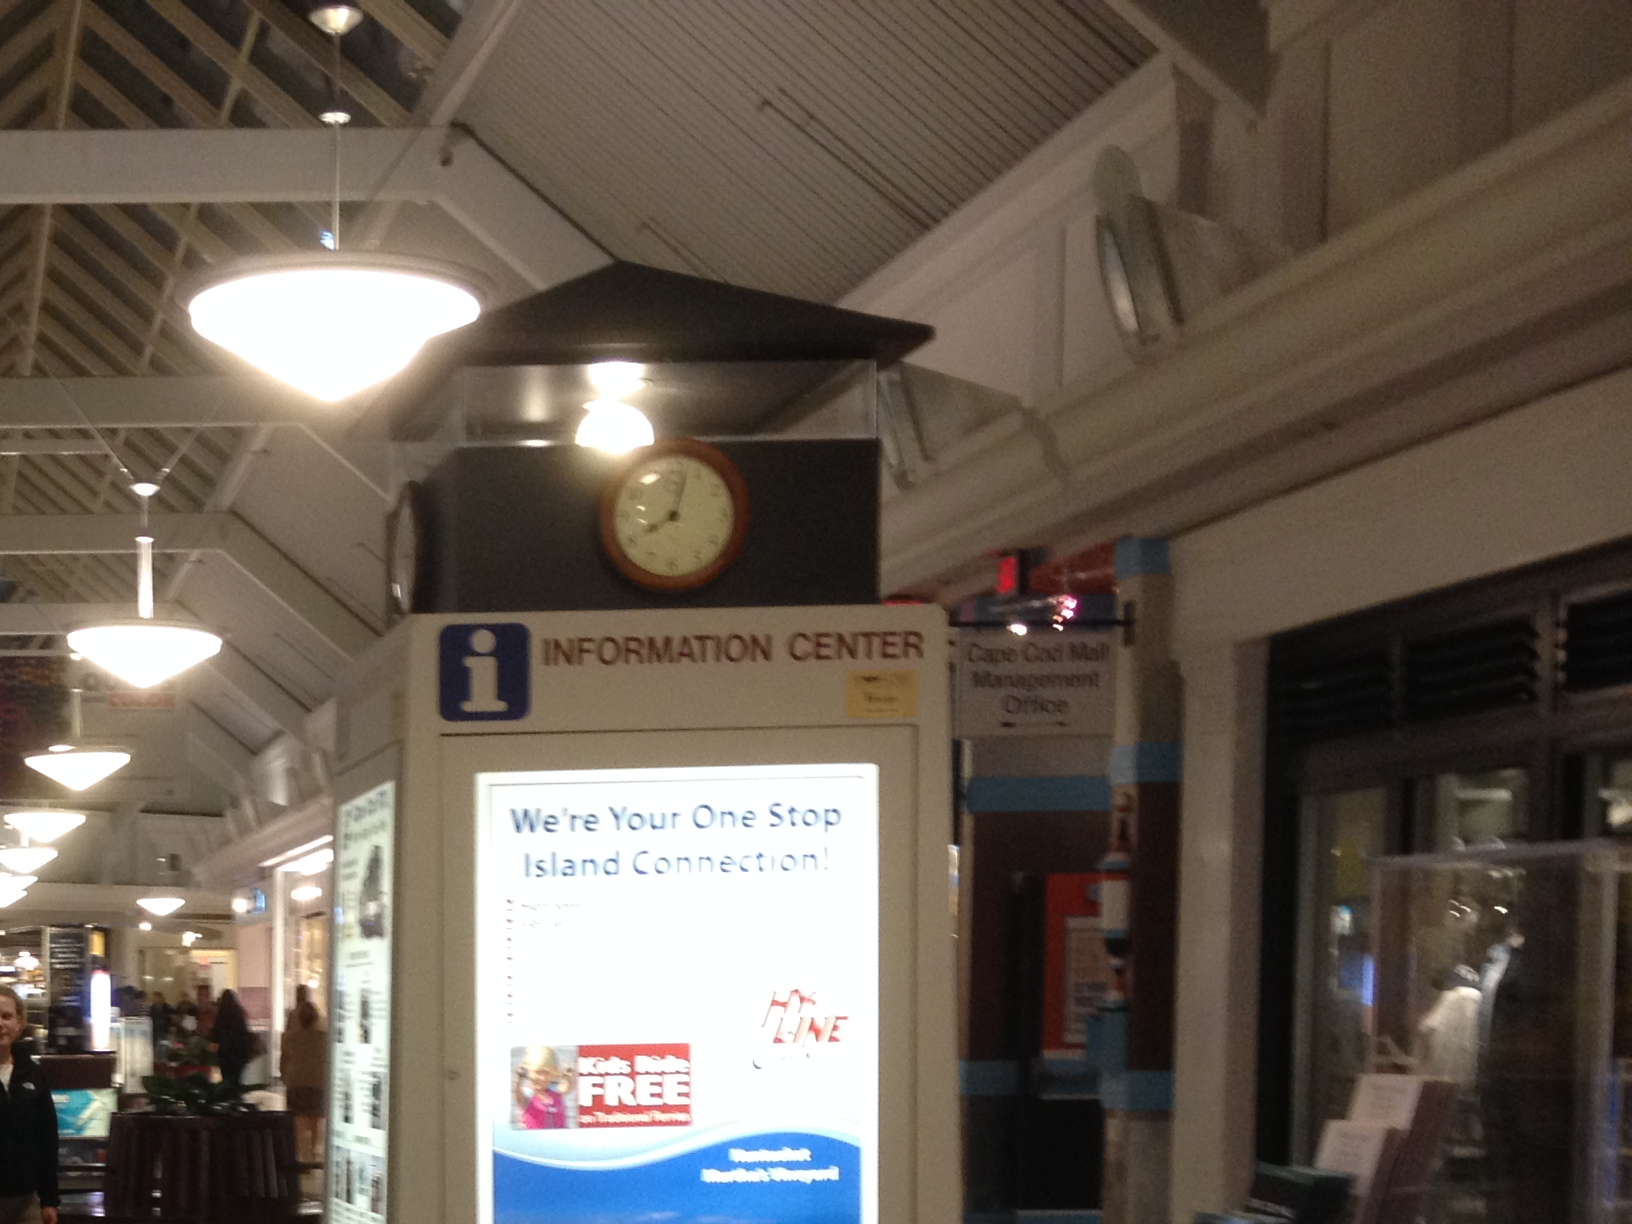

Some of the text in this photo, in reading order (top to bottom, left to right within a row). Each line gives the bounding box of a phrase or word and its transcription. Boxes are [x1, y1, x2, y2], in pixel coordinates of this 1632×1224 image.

[541, 630, 926, 666] INFORMATION CENTER
[968, 640, 1110, 667] Cape Cod Mall
[971, 671, 1101, 691] Management
[1001, 694, 1069, 714] Office
[510, 802, 843, 834] We're Your One Stop
[523, 846, 829, 878] Island Connection!
[578, 1053, 691, 1075] Kids Ride
[578, 1073, 691, 1107] FREE
